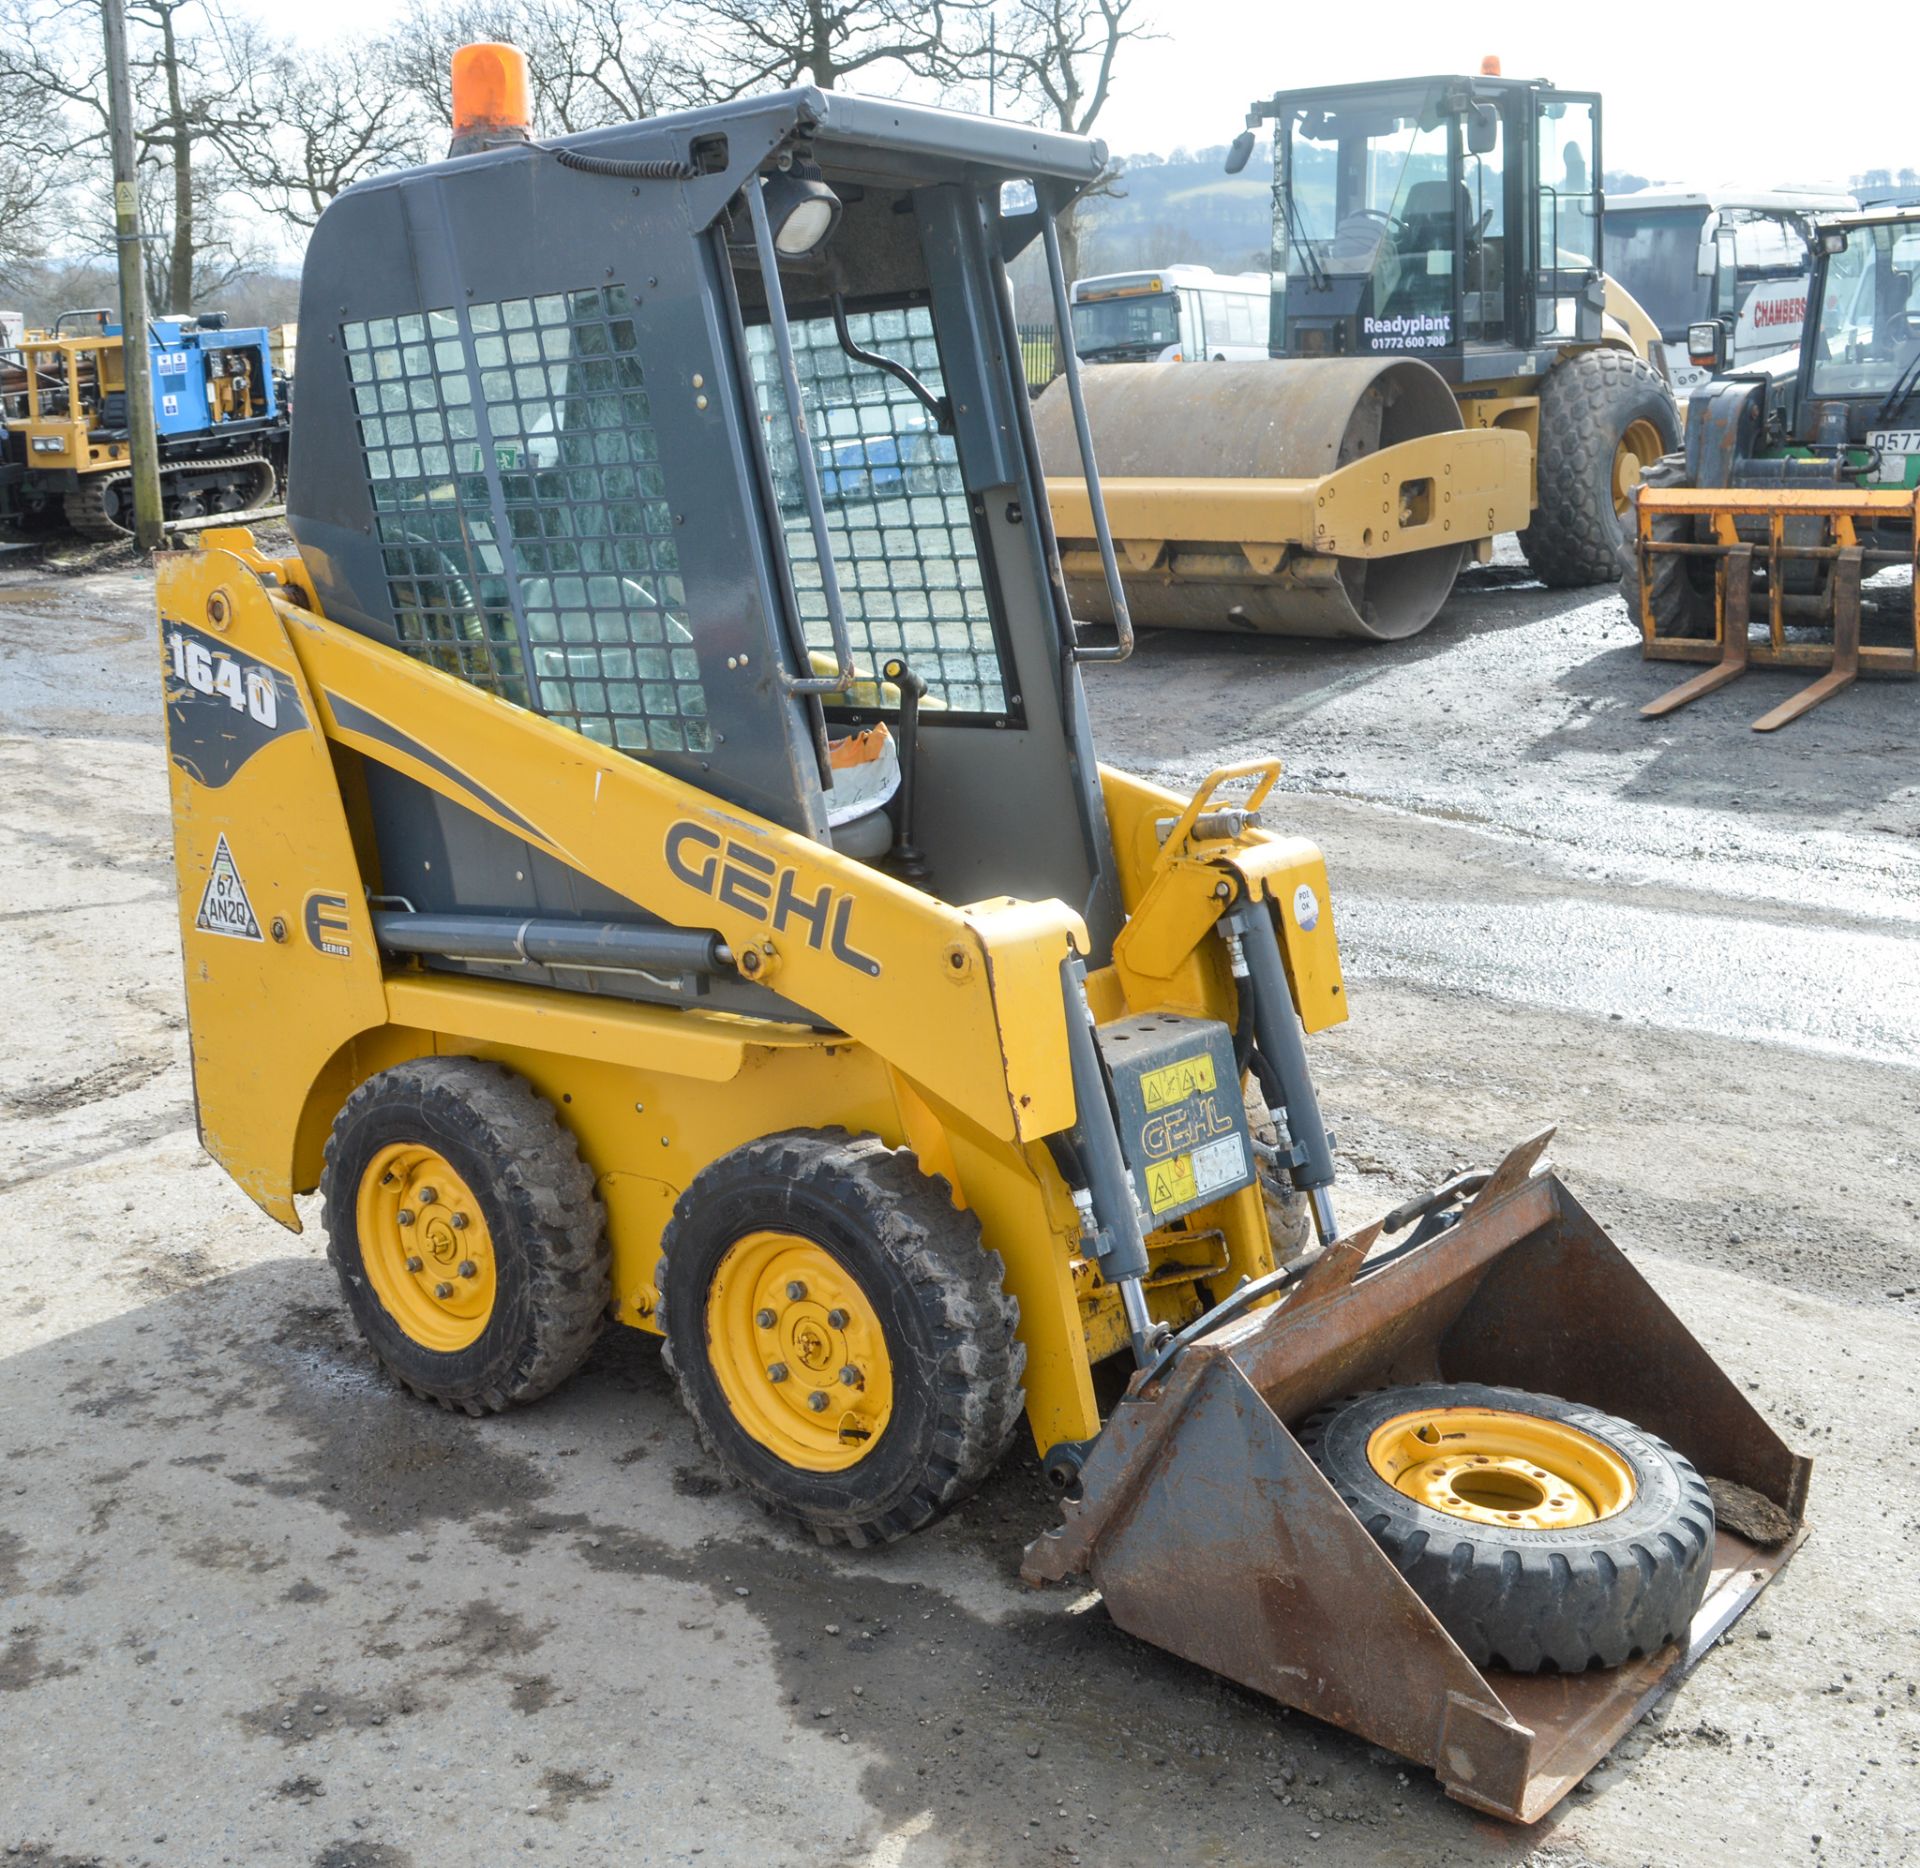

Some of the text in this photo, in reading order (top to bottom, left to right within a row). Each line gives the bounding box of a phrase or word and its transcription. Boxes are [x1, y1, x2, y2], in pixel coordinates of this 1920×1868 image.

[1364, 314, 1450, 336] Readyplant
[1754, 297, 1808, 328] CHAMBERS
[1371, 336, 1446, 350] 01772 600 700
[168, 631, 278, 730] 1640
[216, 873, 234, 897] 67
[664, 819, 882, 978] GEHL
[1302, 901, 1311, 911] OK
[210, 898, 246, 926] AN2Q
[322, 942, 349, 956] SERIES
[1142, 1096, 1233, 1159] GEHL
